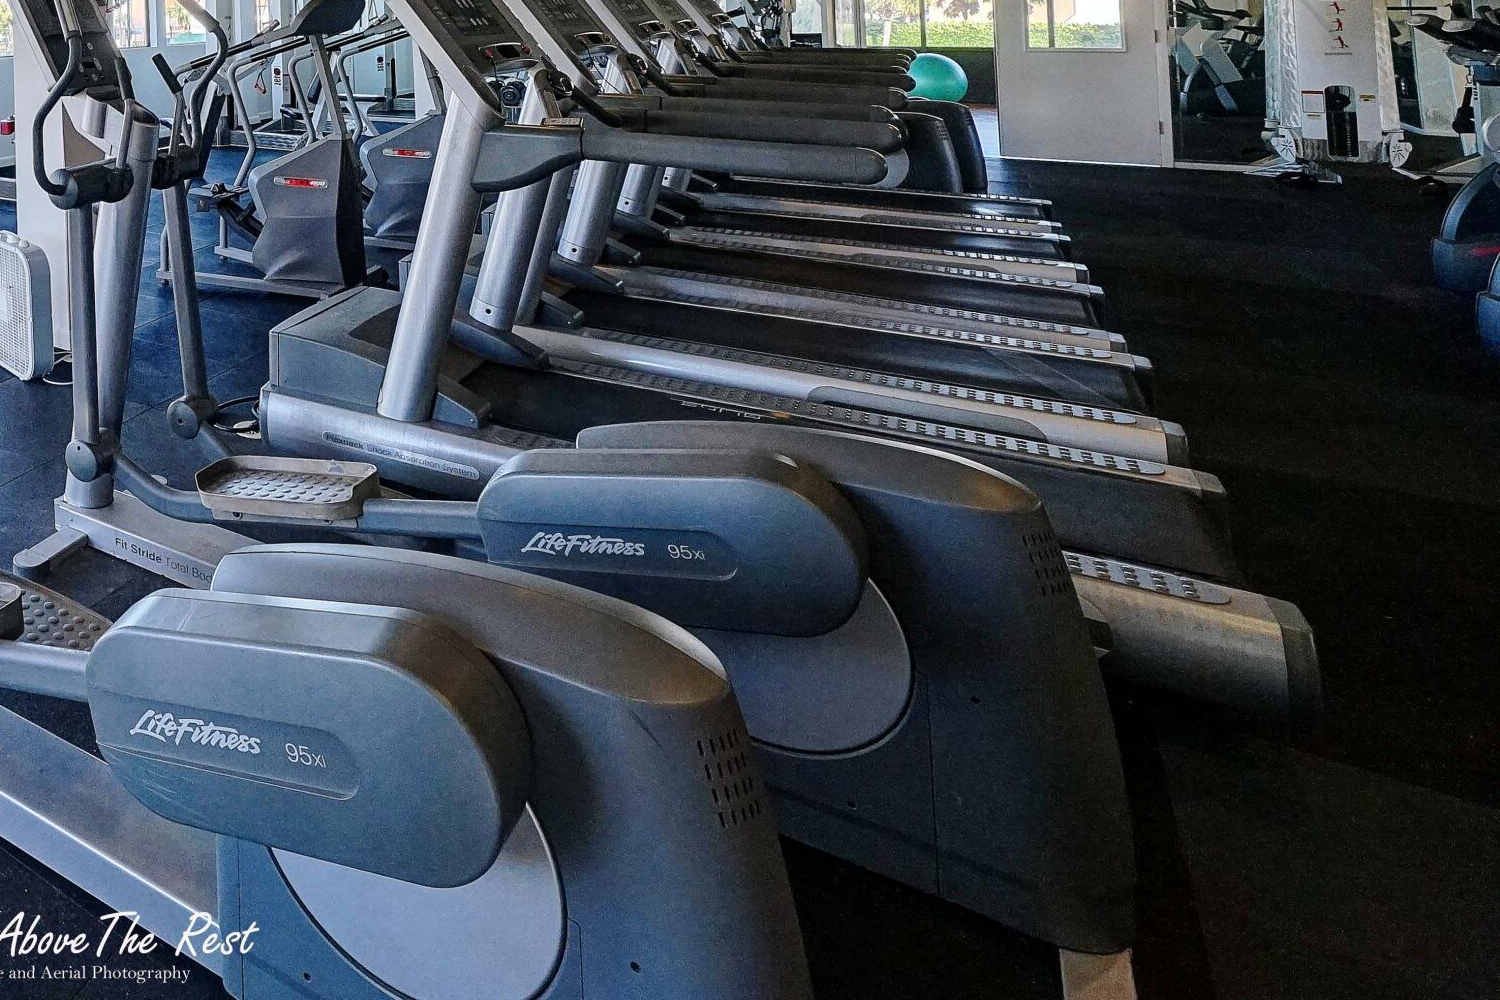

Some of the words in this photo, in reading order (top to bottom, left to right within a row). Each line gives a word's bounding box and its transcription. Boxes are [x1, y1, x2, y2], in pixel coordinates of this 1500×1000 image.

[394, 450, 441, 470] Absorption
[443, 463, 478, 479] System
[115, 537, 128, 550] Fit
[130, 543, 162, 564] Stride
[164, 556, 189, 575] Total
[191, 566, 213, 584] Bod
